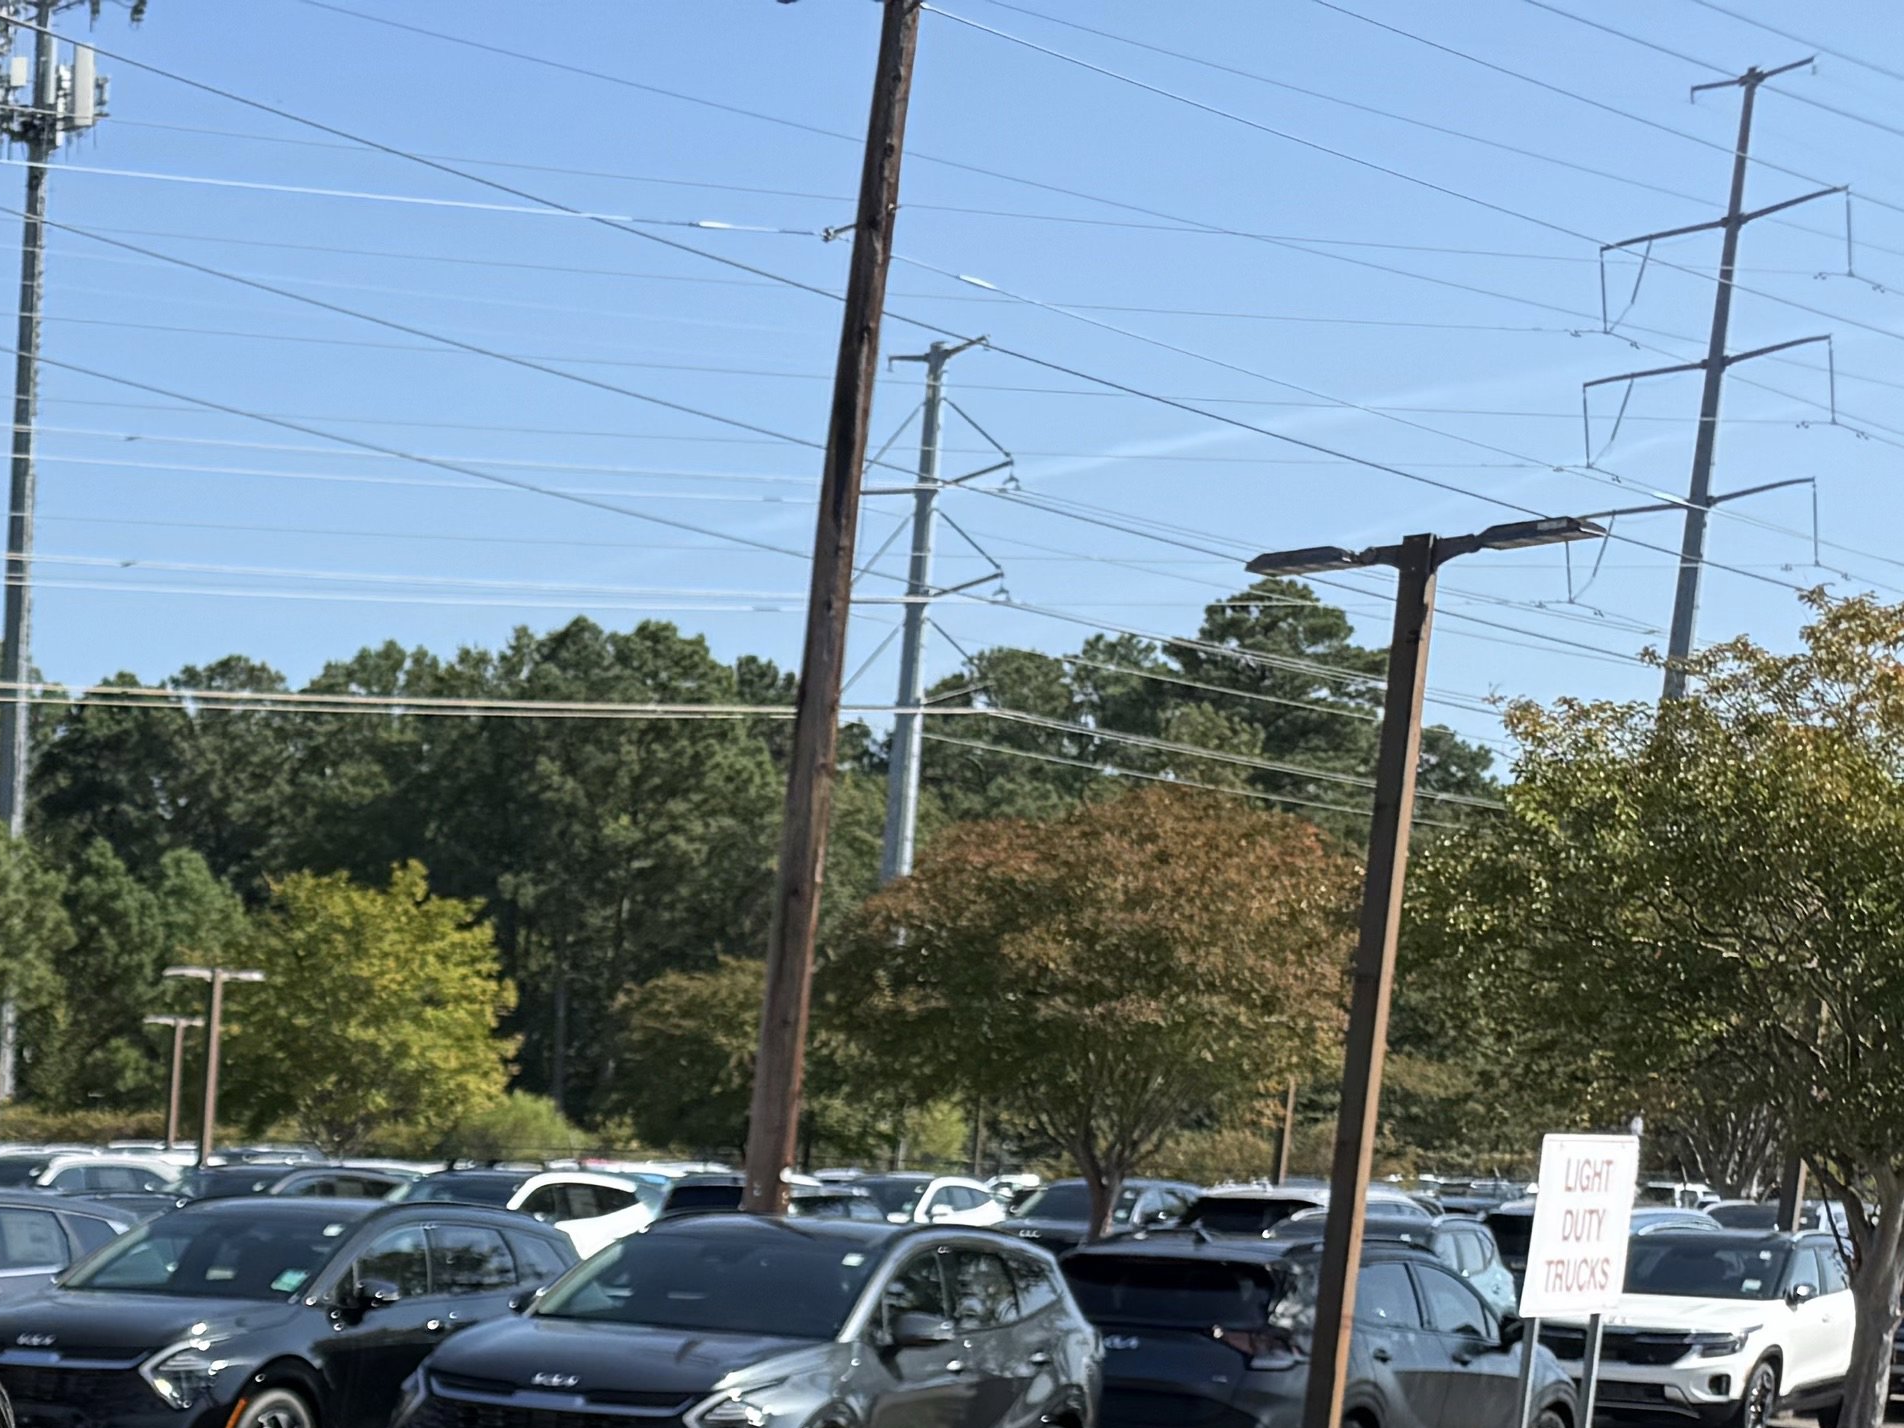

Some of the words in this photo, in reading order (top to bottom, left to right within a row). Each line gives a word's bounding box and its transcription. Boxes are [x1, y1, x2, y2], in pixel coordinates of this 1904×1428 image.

[1564, 1157, 1614, 1193] LIGHT
[1561, 1208, 1606, 1243] DUTY
[1544, 1256, 1611, 1293] TRUCKS
